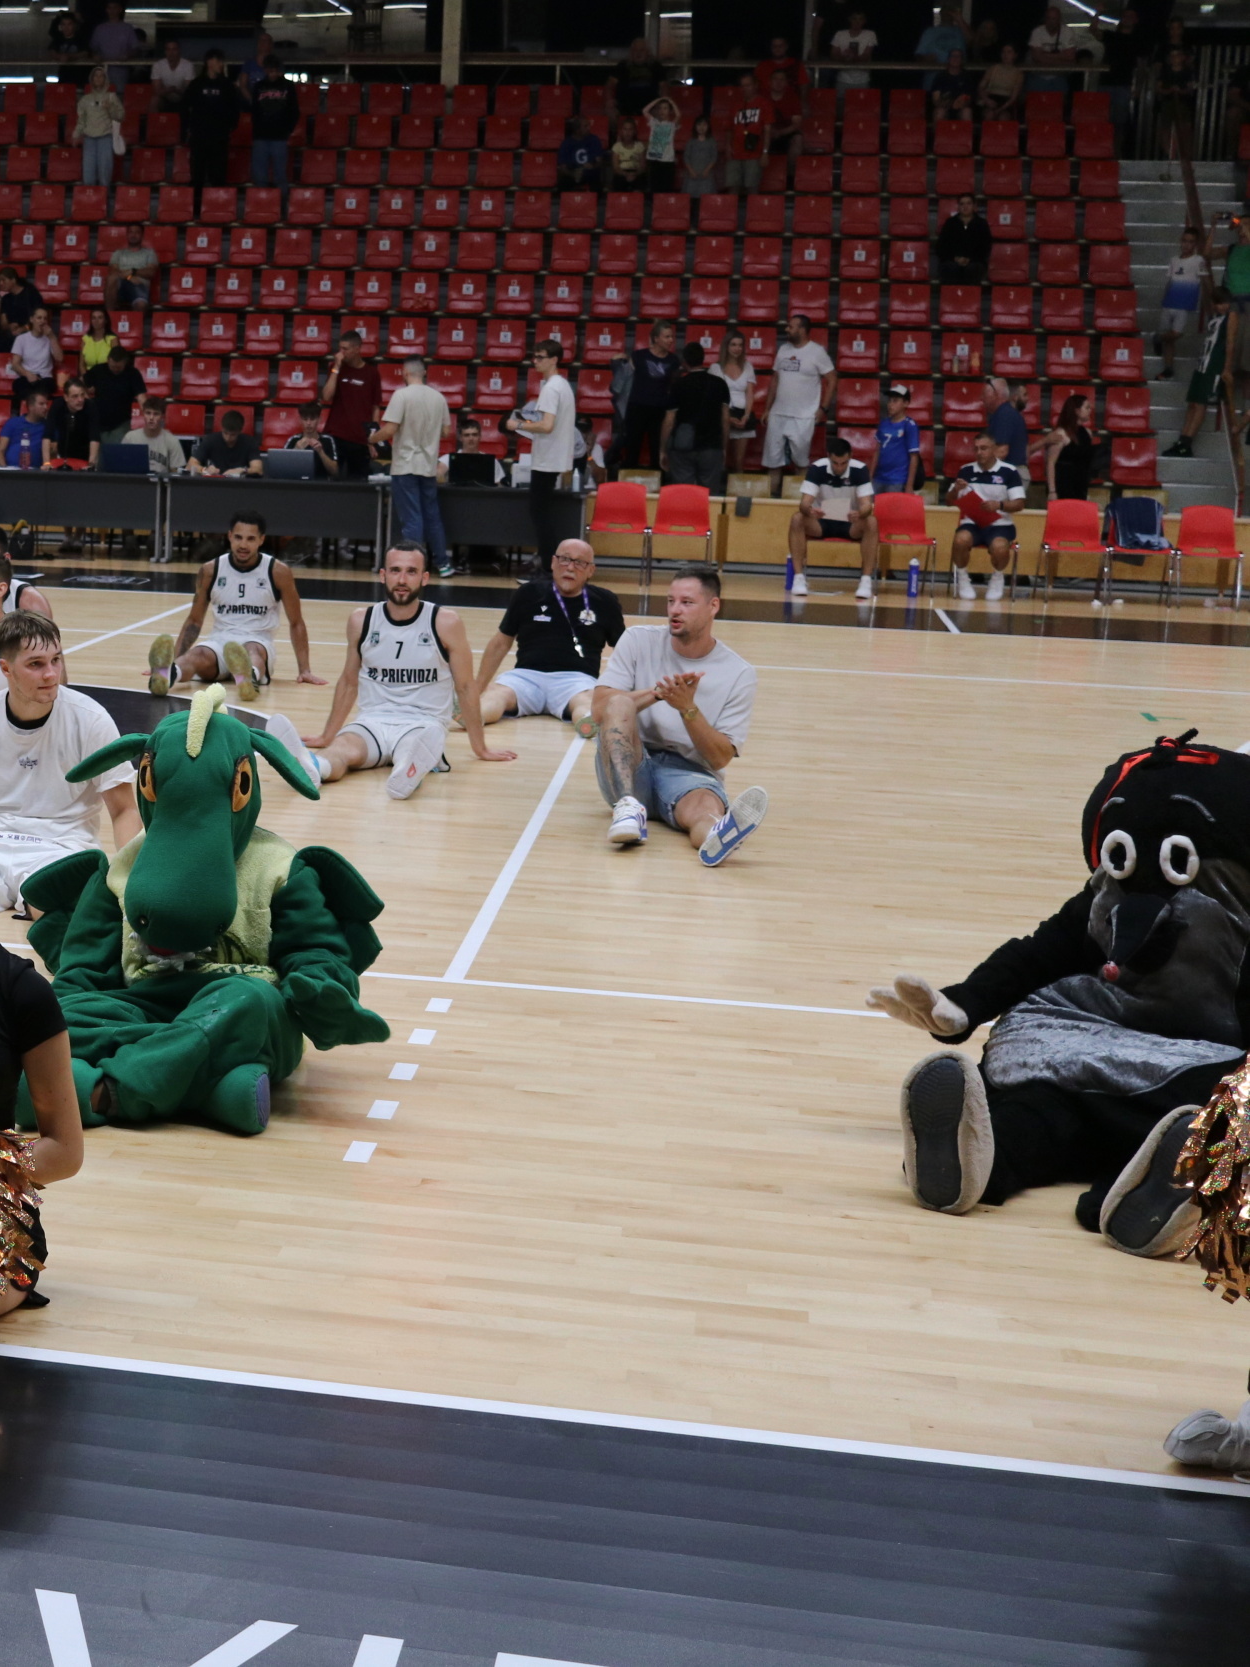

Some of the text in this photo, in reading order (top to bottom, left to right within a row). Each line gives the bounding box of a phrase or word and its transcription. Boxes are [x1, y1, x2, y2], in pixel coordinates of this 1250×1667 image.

[575, 148, 588, 164] G
[883, 433, 892, 448] 7
[238, 583, 245, 598] 9
[395, 641, 404, 659] 7
[381, 668, 438, 683] PRIEVIDZA
